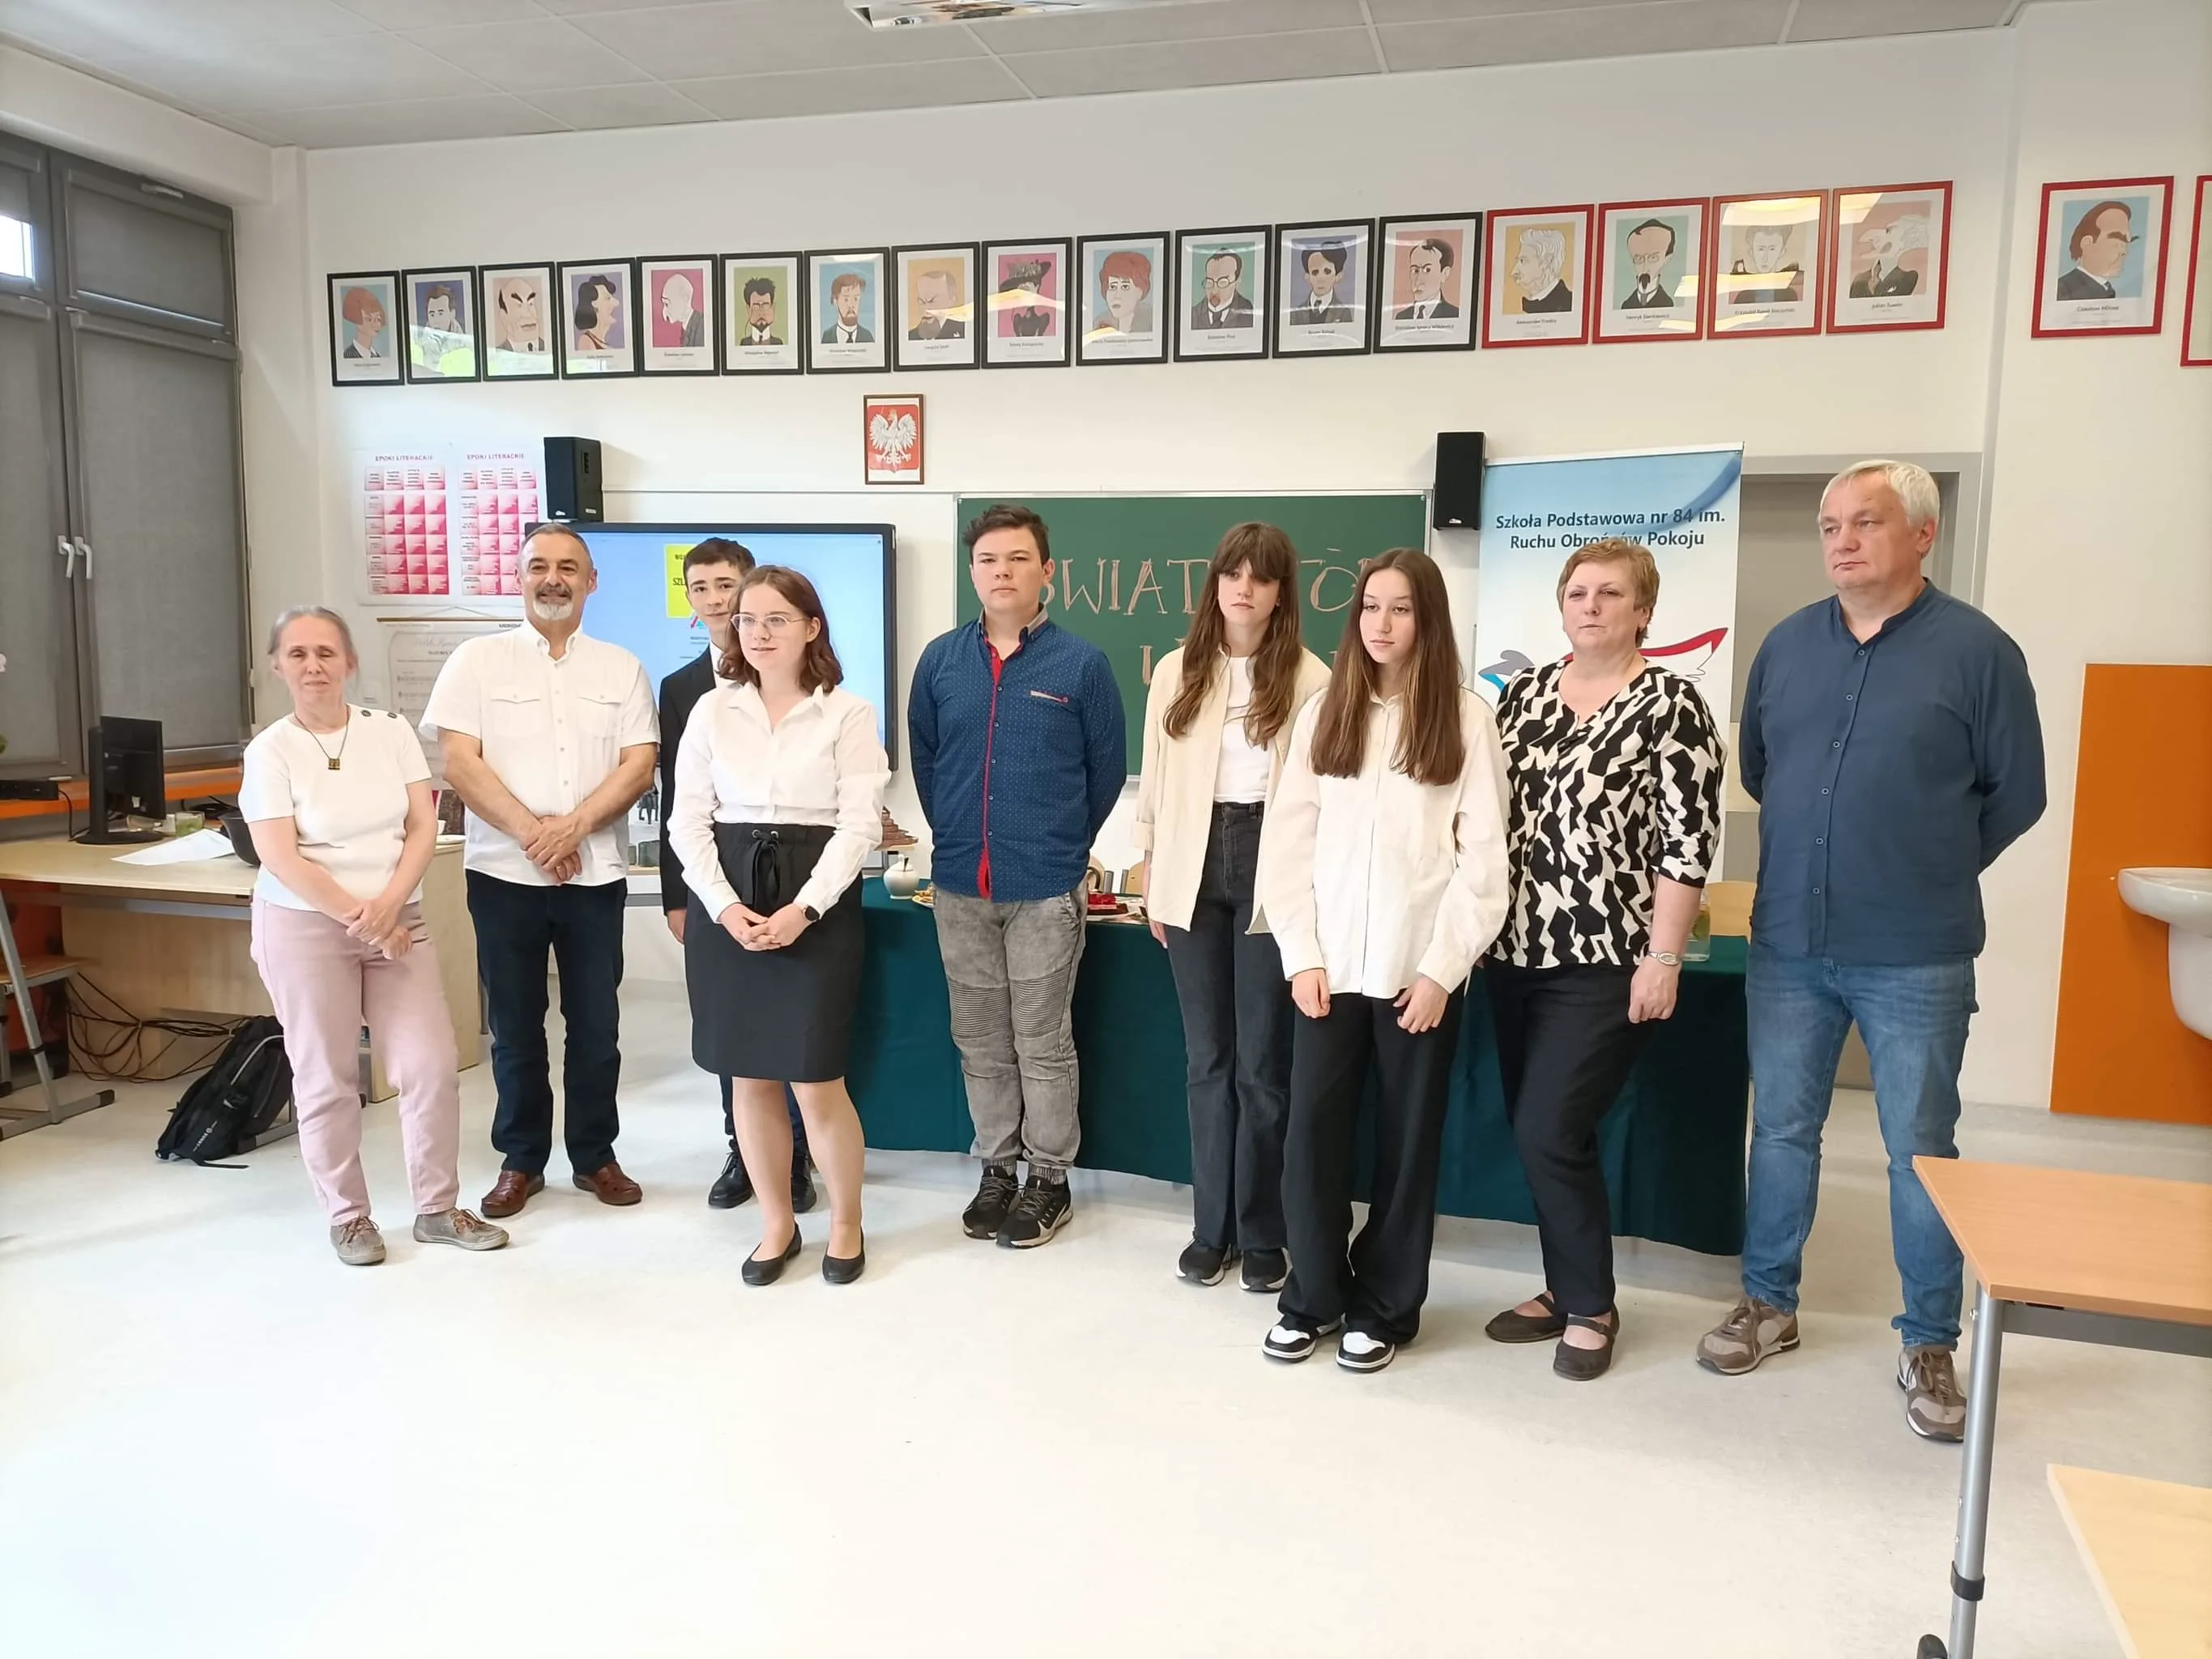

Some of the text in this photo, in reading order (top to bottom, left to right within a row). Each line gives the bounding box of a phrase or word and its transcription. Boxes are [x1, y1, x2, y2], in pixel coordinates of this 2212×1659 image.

[1496, 509, 1726, 529] Szkoła Podstawowa nr 84 im.
[1511, 534, 1556, 549] Ruchu
[1647, 531, 1705, 549] Pokoju
